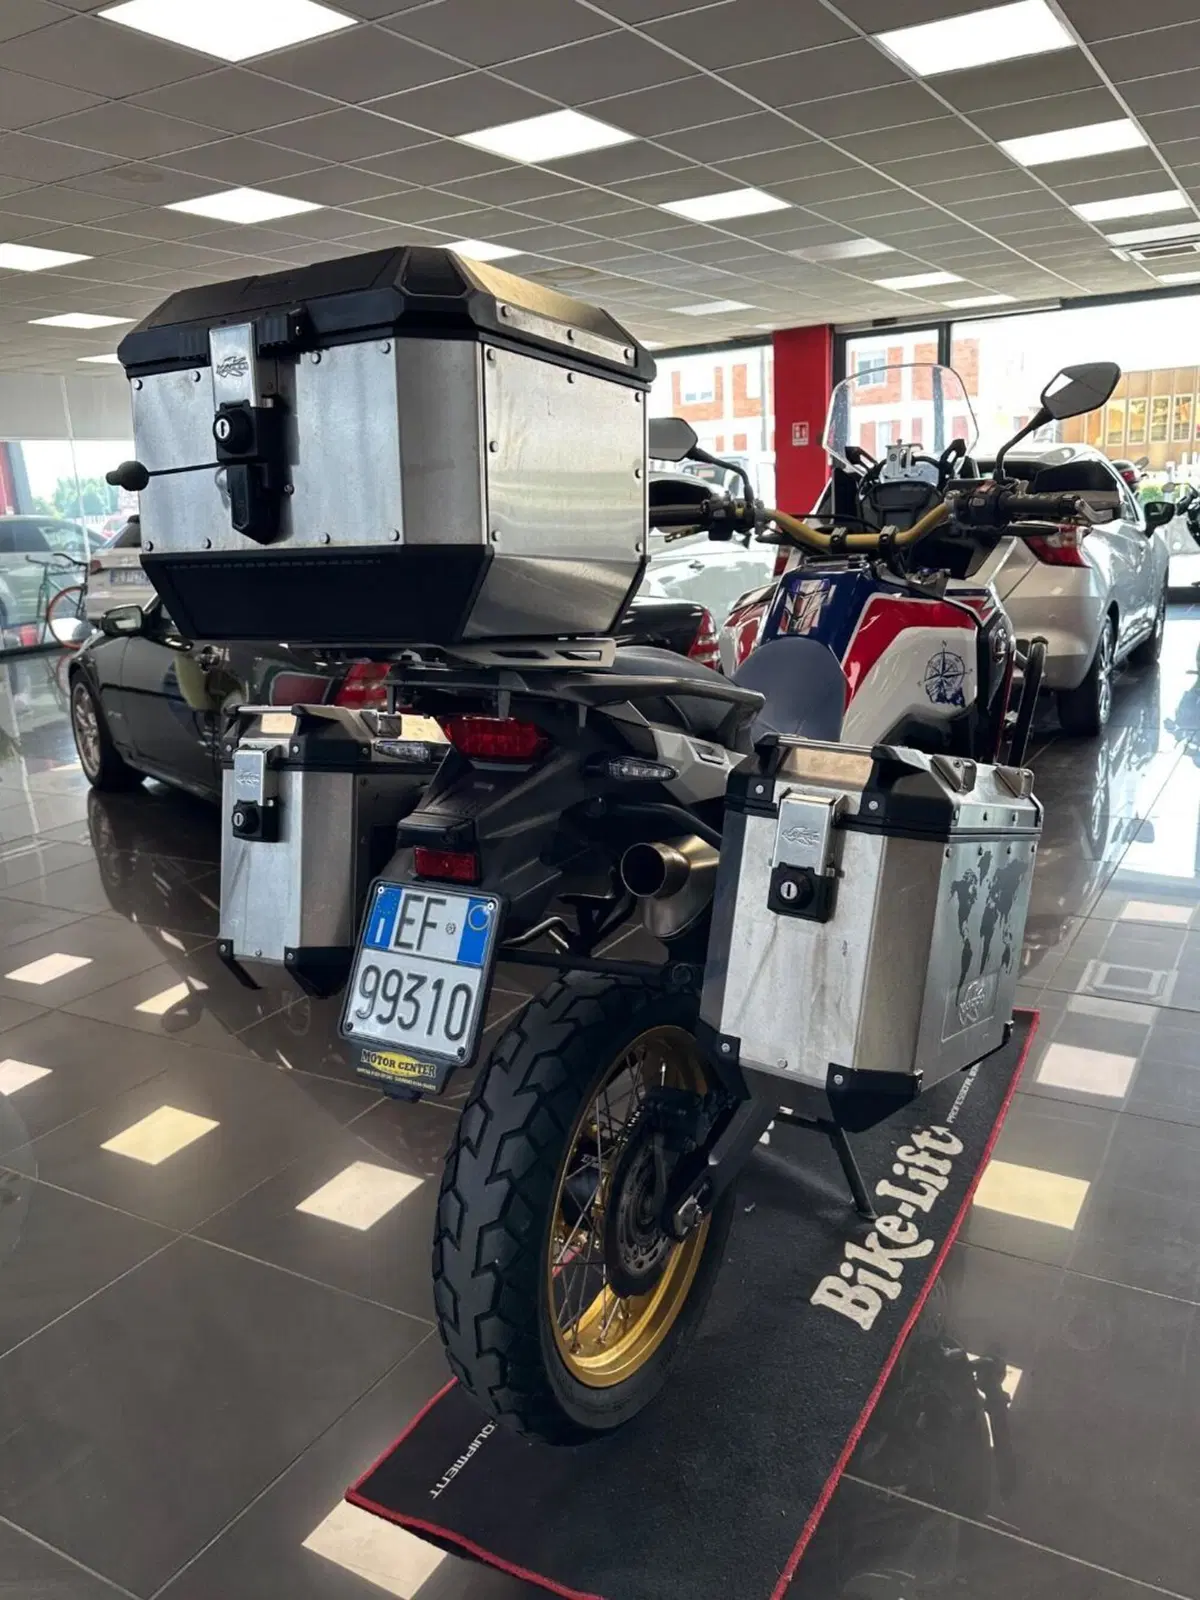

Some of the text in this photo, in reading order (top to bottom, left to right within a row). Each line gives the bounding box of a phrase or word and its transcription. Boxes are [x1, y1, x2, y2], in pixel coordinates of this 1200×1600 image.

[394, 893, 447, 951] EF
[355, 964, 473, 1041] 99310
[361, 1048, 396, 1069] MOTOR
[397, 1061, 437, 1078] CENTER
[810, 1125, 964, 1331] Bike-Lift
[430, 1420, 498, 1499] QUIPMENT
